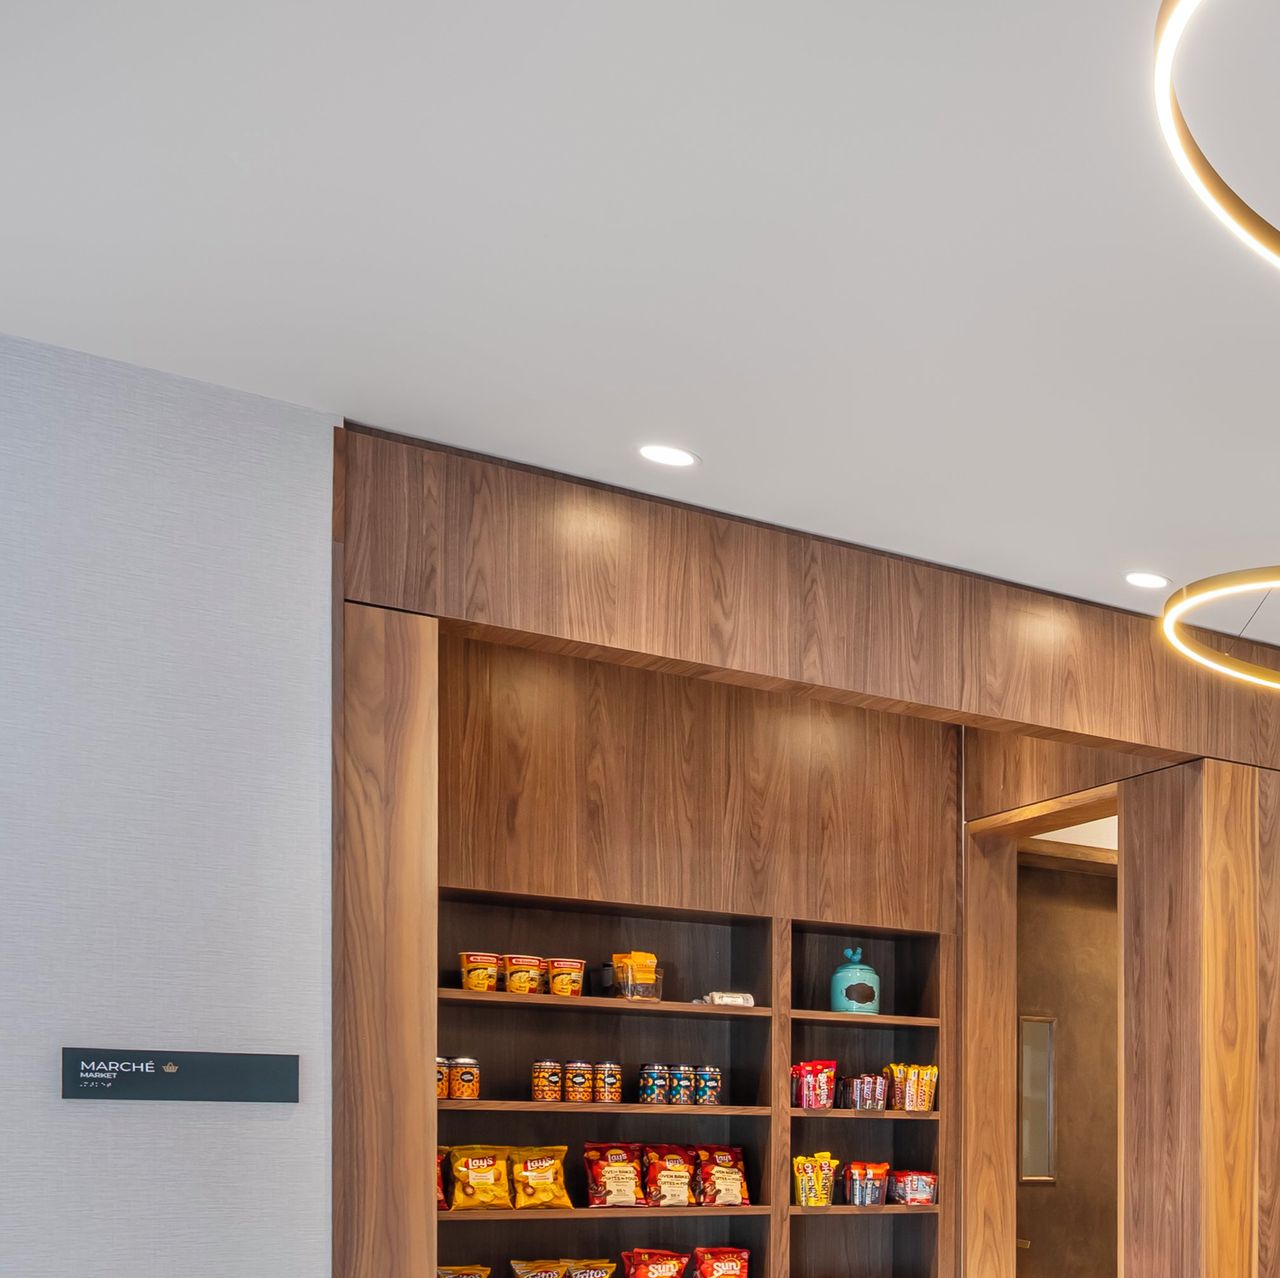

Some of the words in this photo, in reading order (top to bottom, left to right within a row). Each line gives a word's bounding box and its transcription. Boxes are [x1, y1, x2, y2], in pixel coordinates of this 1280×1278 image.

[80, 1060, 156, 1072] MARCHÉ
[468, 1157, 493, 1169] Lay's
[527, 1157, 554, 1170] Lay's
